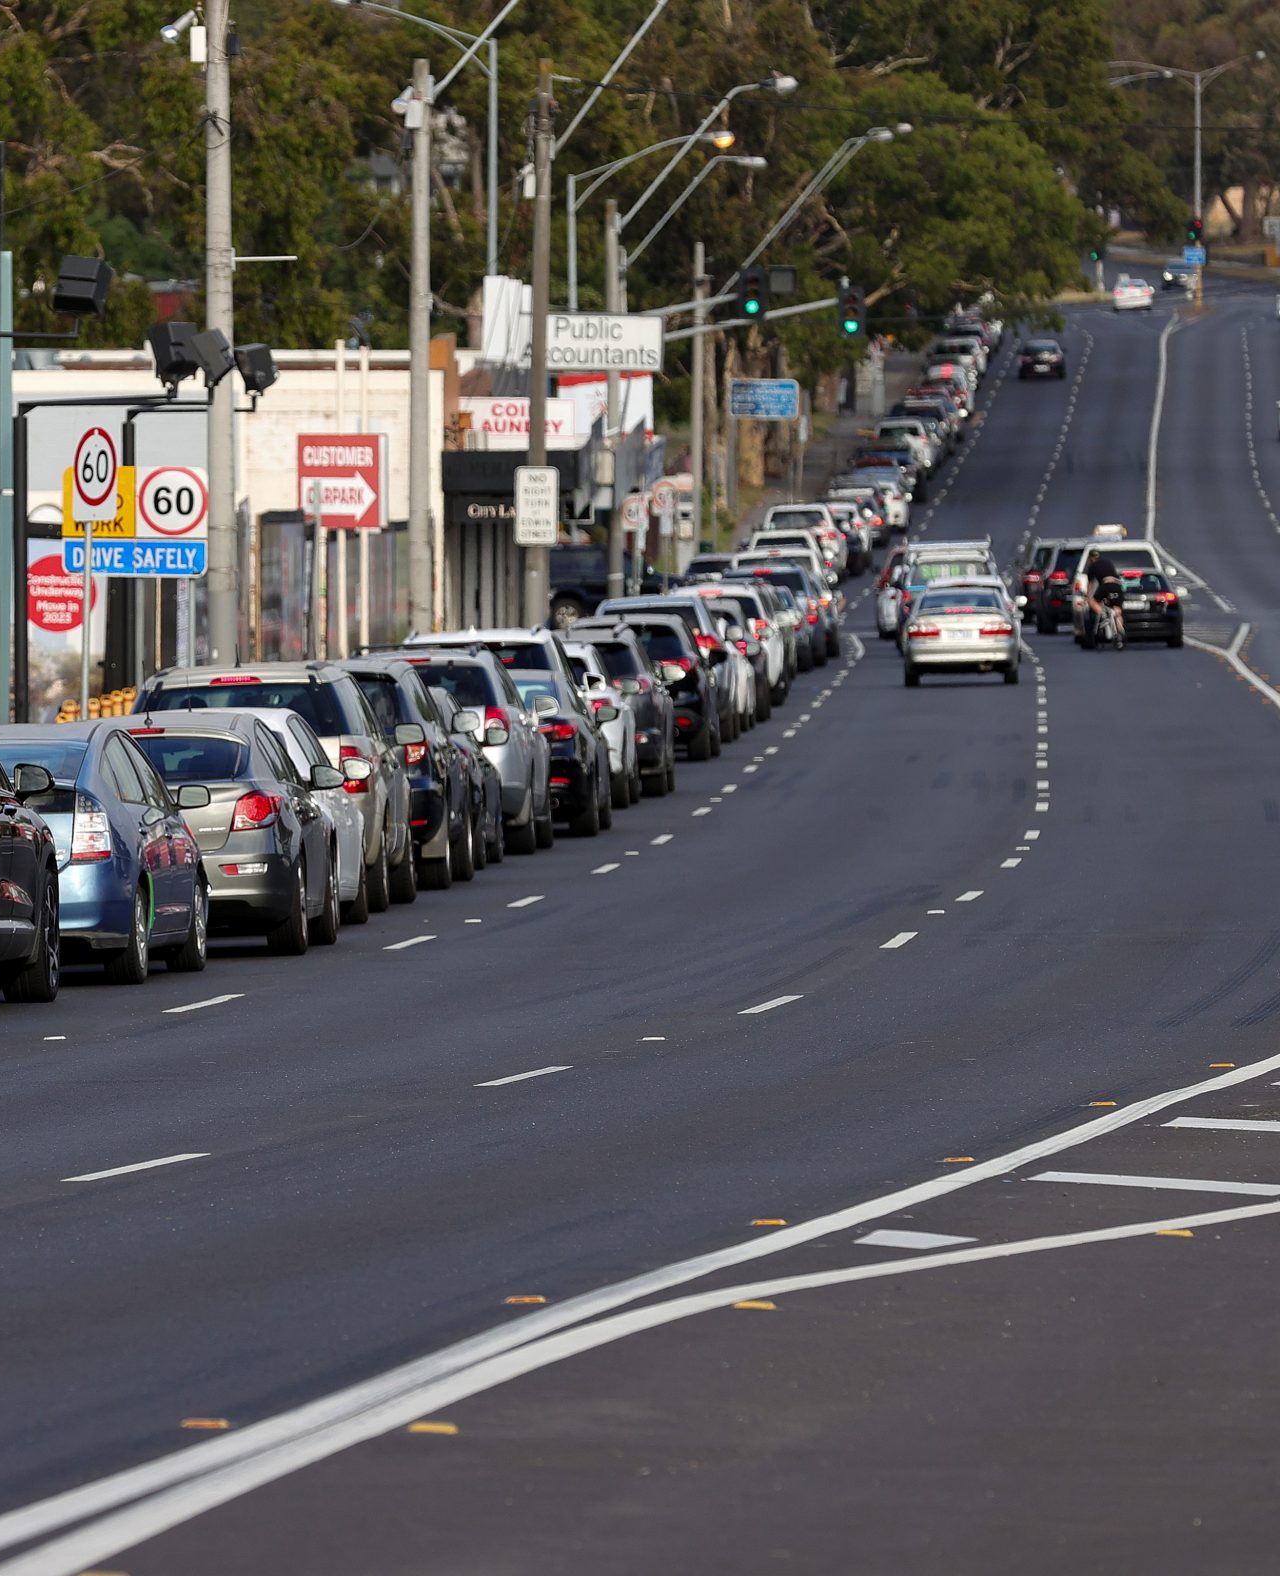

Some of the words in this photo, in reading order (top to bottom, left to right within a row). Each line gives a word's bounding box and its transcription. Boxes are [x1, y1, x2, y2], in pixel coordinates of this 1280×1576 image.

[553, 316, 623, 340] Public
[82, 450, 108, 483] 60
[303, 446, 373, 467] CUSTOMER
[153, 486, 194, 515] 60
[132, 547, 197, 569] SAFELY
[36, 600, 66, 613] Move
[67, 600, 80, 613] in
